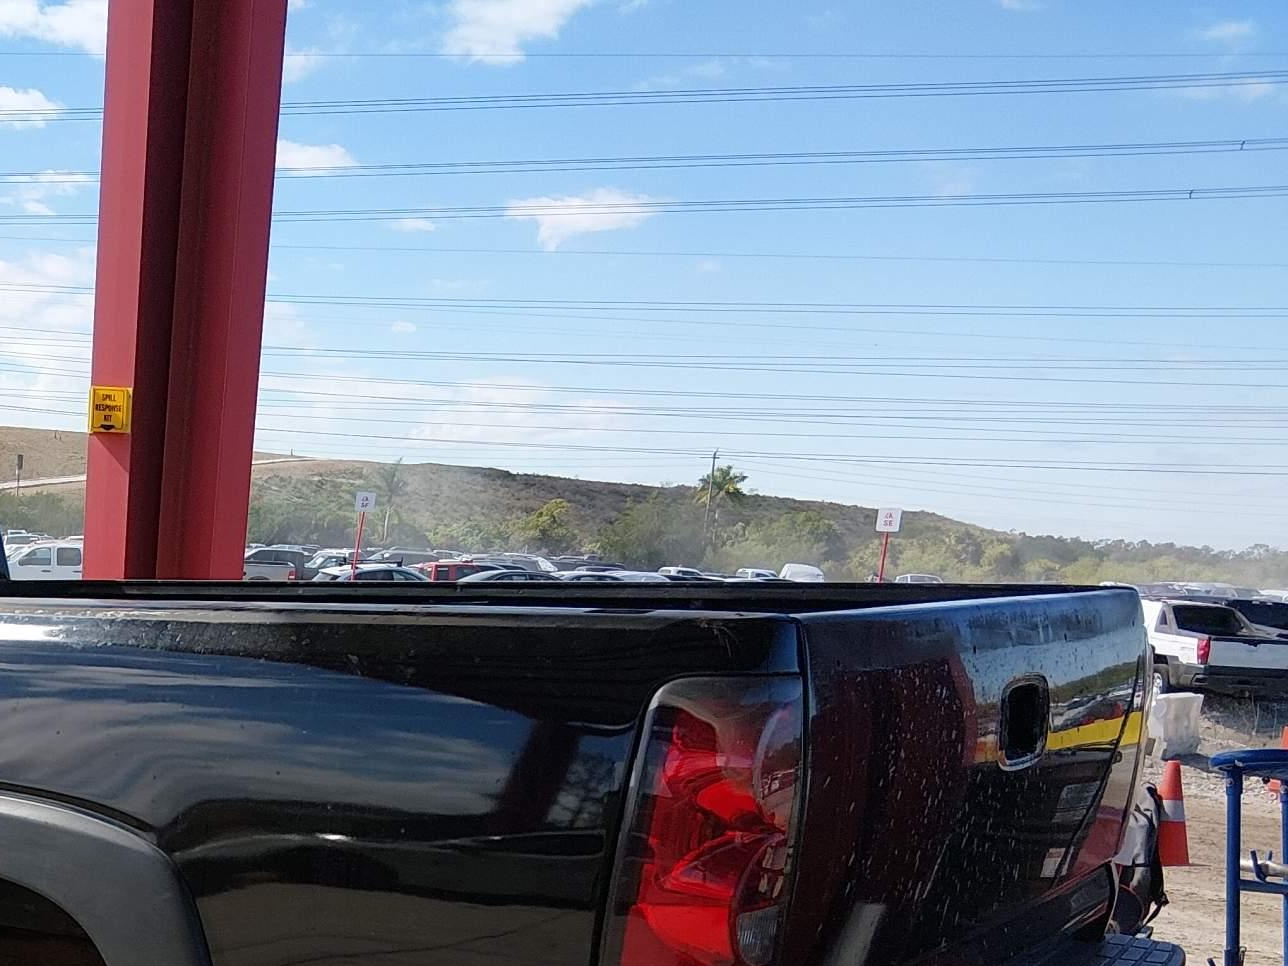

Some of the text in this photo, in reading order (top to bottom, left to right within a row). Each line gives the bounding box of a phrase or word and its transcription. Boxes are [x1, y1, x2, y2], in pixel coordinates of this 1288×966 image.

[101, 393, 116, 402] SPILL
[95, 403, 122, 413] RESPONSE
[103, 414, 113, 422] KIT
